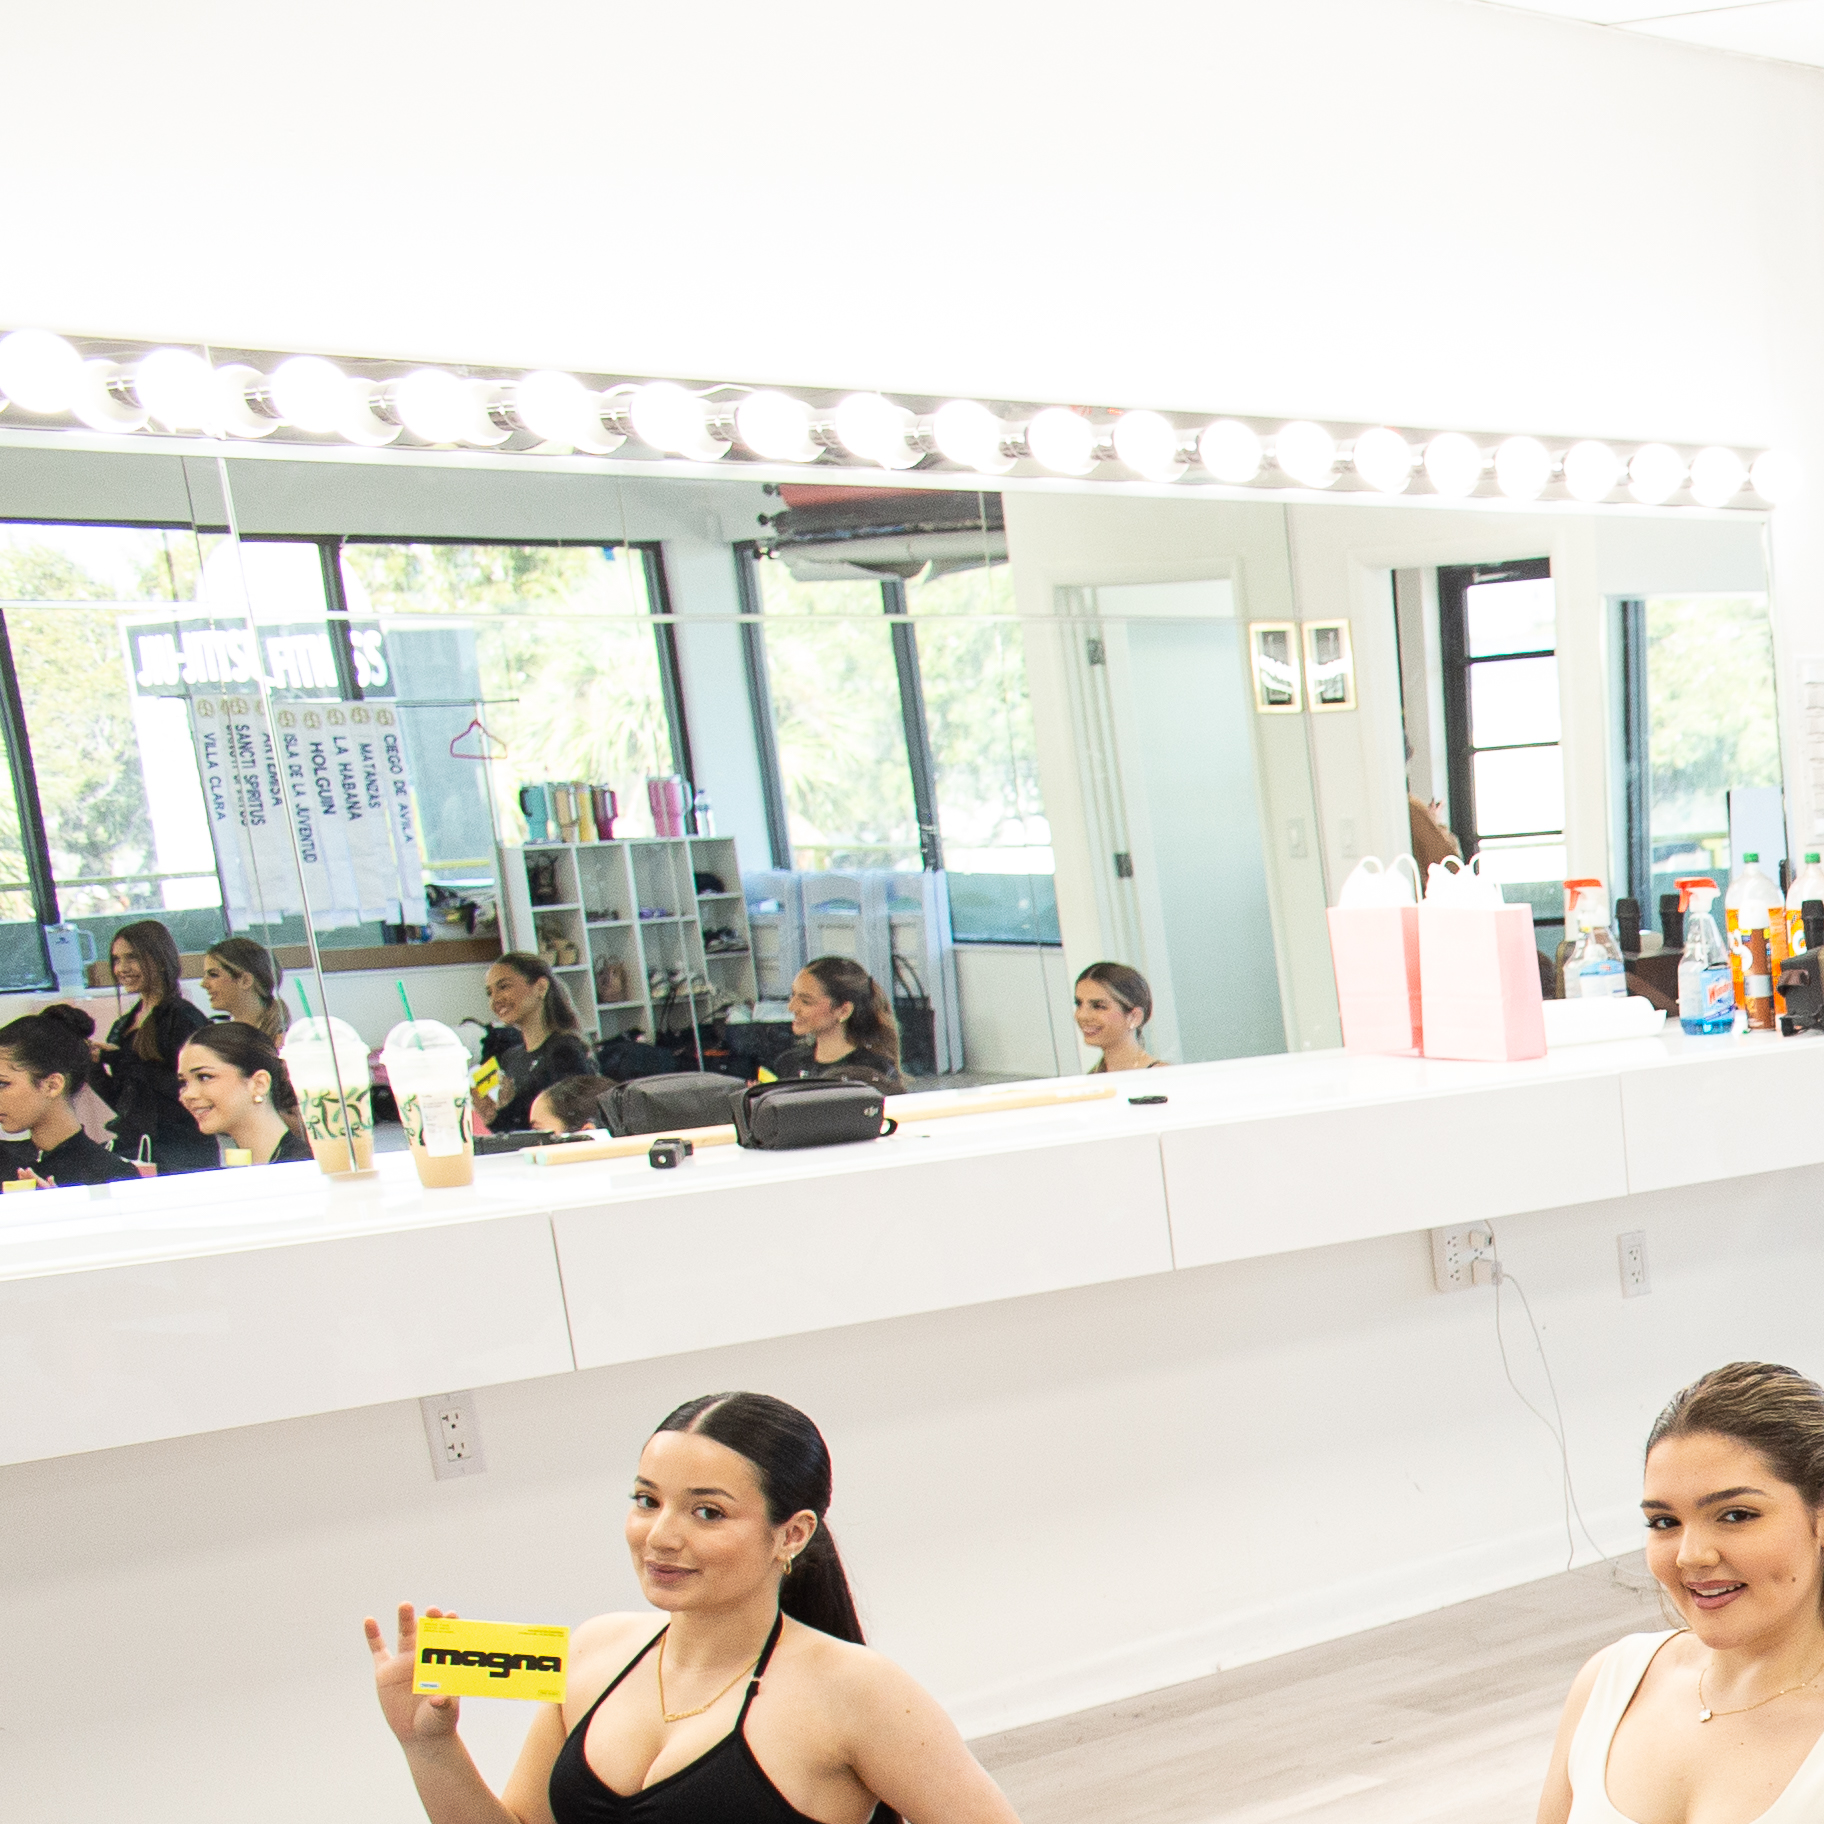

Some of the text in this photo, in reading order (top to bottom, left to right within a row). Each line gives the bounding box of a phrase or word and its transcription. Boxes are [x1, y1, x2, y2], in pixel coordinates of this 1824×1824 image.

[234, 724, 257, 769] SANCTI
[383, 734, 403, 775] CIEGO
[203, 732, 226, 821] VILLA CLARA
[288, 764, 303, 778] DE
[293, 783, 307, 797] LA
[310, 741, 337, 816] HOLGUIN
[333, 736, 363, 821] LA HABANA
[359, 742, 381, 809] MATANZAS
[392, 779, 407, 797] DE
[243, 774, 266, 826] SPIRITUS
[421, 1647, 562, 1679] magna
